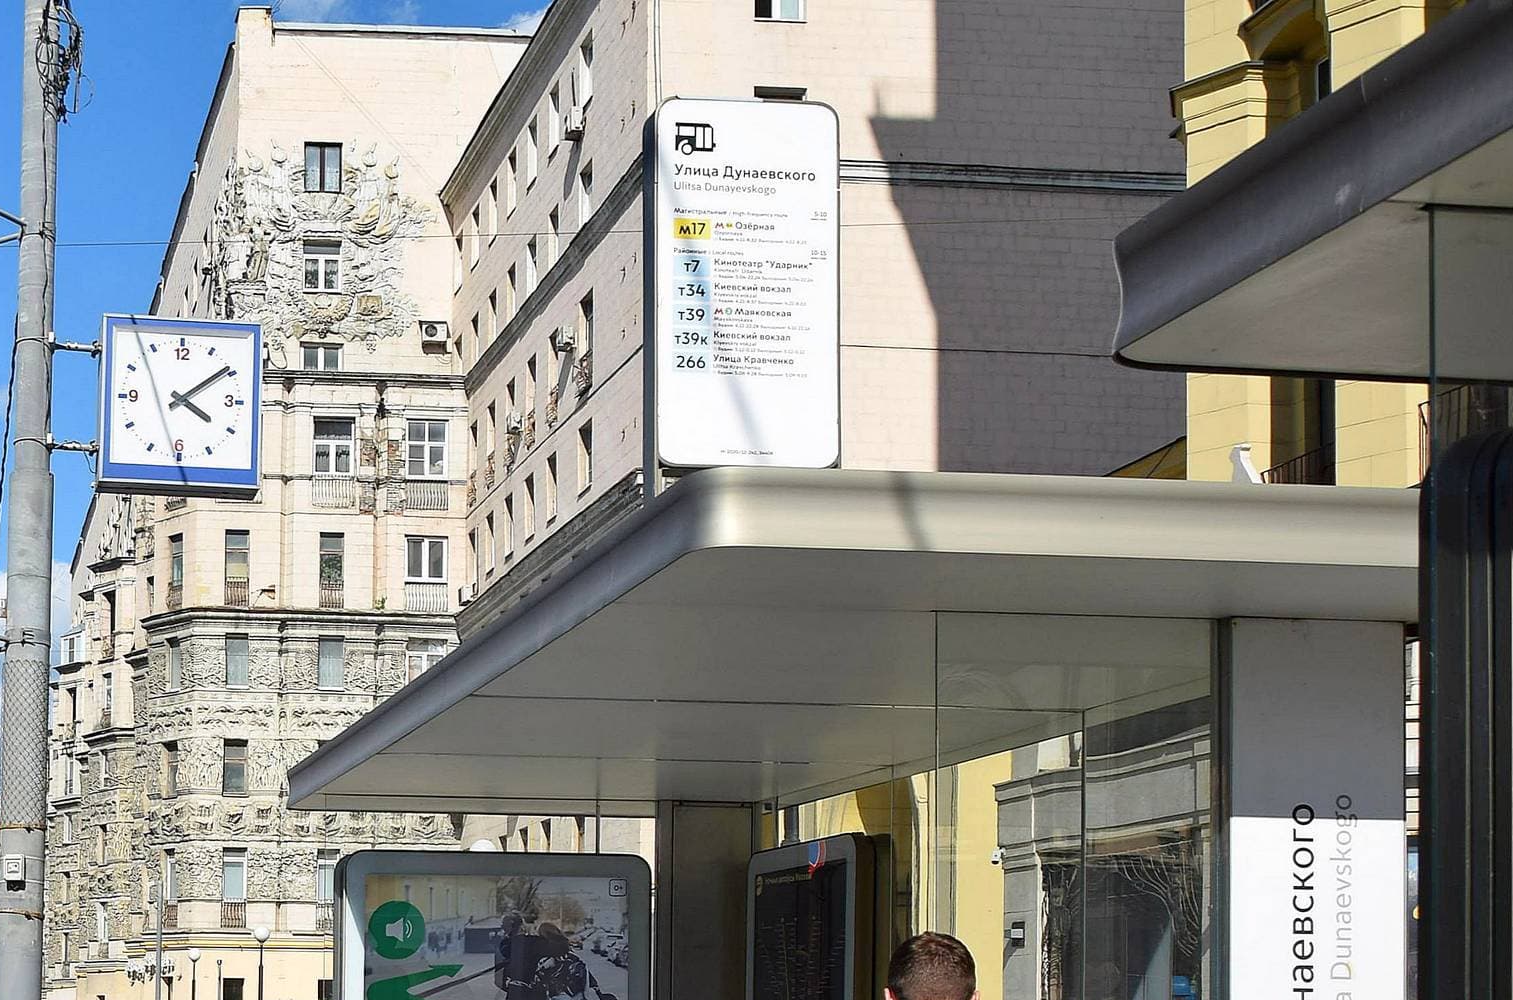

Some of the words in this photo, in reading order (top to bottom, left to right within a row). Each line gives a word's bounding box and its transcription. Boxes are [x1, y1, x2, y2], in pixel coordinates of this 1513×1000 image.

[674, 163, 719, 178] Улица
[722, 165, 816, 182] Дунаевского
[673, 181, 702, 191] Ulitsa
[704, 182, 777, 196] Dunayevskogo
[735, 222, 775, 232] Озёрная
[714, 258, 763, 269] Кинотеатр
[714, 282, 758, 291] Киевский
[760, 285, 791, 293] вокзал
[734, 308, 792, 318] Маяковская
[713, 331, 758, 340] Киевский
[759, 334, 791, 342] вокзал
[174, 347, 190, 361] 12
[713, 354, 742, 364] Улица
[744, 356, 794, 365] Кравченко
[676, 355, 706, 369] 266
[128, 389, 139, 403] 9
[223, 394, 234, 408] 3
[174, 439, 184, 452] 6
[1329, 793, 1358, 982] Dunaevskogo
